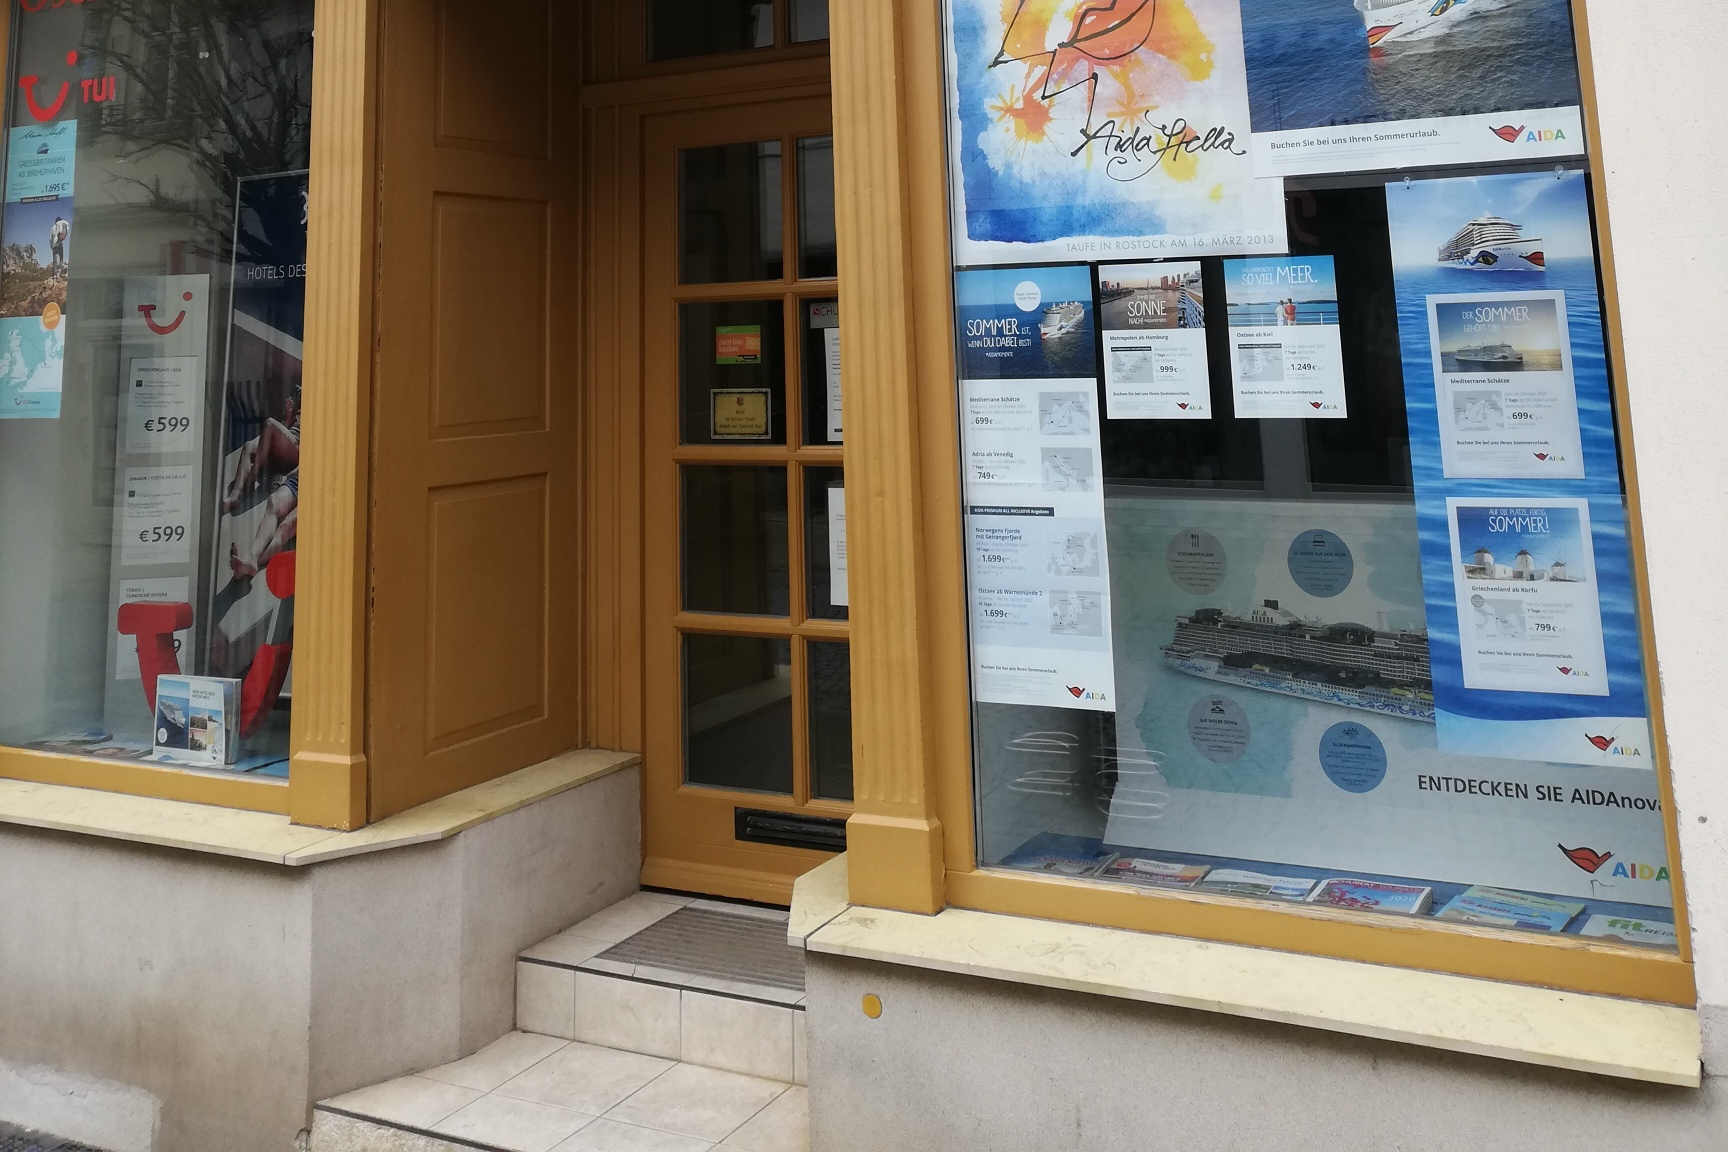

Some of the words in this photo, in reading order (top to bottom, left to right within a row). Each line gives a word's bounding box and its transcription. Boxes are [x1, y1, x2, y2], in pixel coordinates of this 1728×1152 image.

[80, 76, 116, 104] TUI
[1270, 140, 1301, 150] Buchen
[1303, 139, 1315, 148] Sie
[1316, 137, 1330, 146] bei
[1332, 137, 1347, 145] uns
[1349, 134, 1372, 143] Ihren
[1374, 129, 1441, 142] Sommerurlaub.
[1525, 128, 1566, 143] AIDA
[1066, 242, 1096, 252] TAUFE
[1100, 242, 1112, 251] IN
[1116, 239, 1167, 250] ROSTOCK
[1170, 238, 1188, 248] AM
[1192, 237, 1209, 247] 16.
[1211, 234, 1243, 247] MÄRZ
[1247, 234, 1275, 245] 2013
[247, 265, 285, 280] HOTELS
[1277, 265, 1318, 284] MEER.
[1128, 301, 1166, 316] SONNE
[1462, 311, 1474, 319] DER
[1475, 306, 1530, 322] SOMMER
[967, 318, 1020, 336] SOMMER
[983, 338, 994, 348] DU
[996, 337, 1018, 347] DABEI
[1489, 516, 1550, 533] SOMMER!
[1085, 692, 1106, 701] AIDA
[1612, 746, 1641, 757] AIDA
[1417, 774, 1528, 799] ENTDECKEN
[1535, 785, 1564, 803] SIE
[1611, 861, 1670, 882] AIDA
